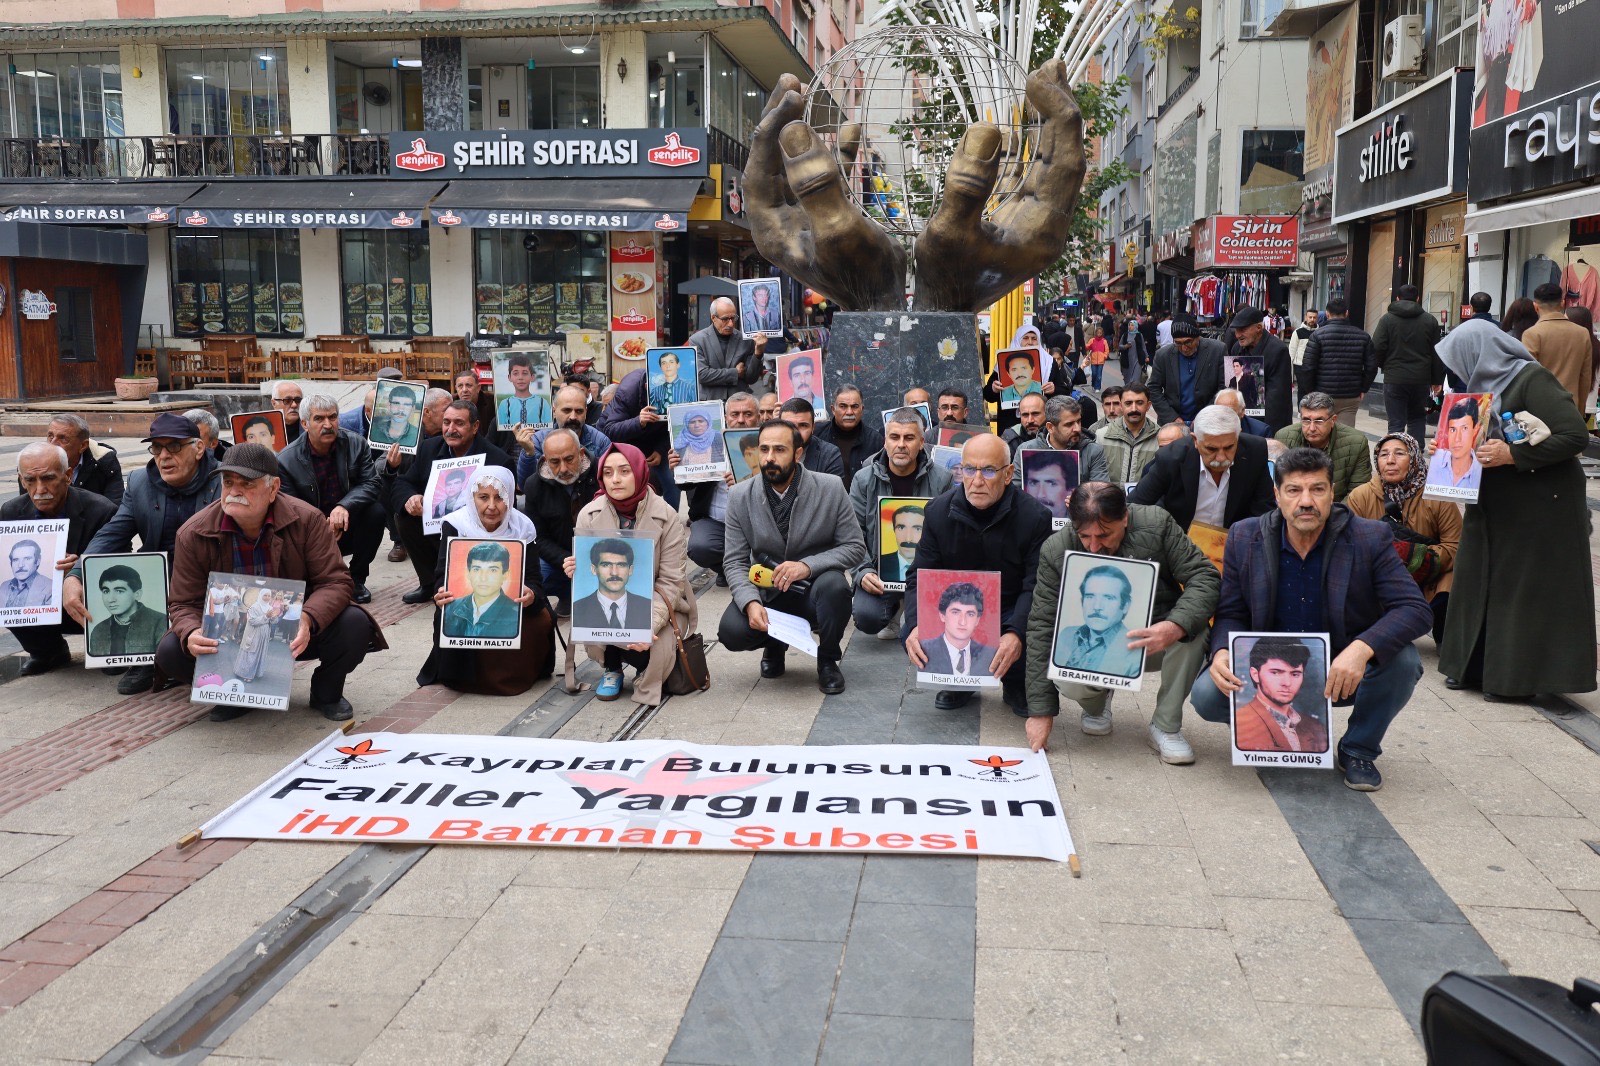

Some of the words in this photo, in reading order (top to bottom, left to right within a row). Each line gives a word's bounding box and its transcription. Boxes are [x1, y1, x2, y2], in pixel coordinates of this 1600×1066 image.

[453, 133, 525, 173] ŞEHİR
[533, 139, 638, 165] SOFRASI
[653, 149, 694, 163] şenpiliç
[1359, 115, 1411, 183] stilife
[401, 154, 439, 168] şenpiliç
[54, 208, 126, 220] SOFRASI
[233, 211, 286, 227] ŞEHİR
[291, 212, 366, 225] SOFRASI
[487, 211, 543, 227] ŞEHİR
[548, 213, 628, 227] SOFRASI
[1231, 219, 1282, 237] Şirin
[1428, 219, 1455, 245] stilife
[1220, 236, 1294, 247] Collection
[23, 302, 51, 313] BATMAN
[37, 523, 65, 533] ÇELİK
[4, 616, 38, 625] KAYBEDİLDİ
[105, 656, 133, 665] ÇETİN
[953, 676, 981, 685] KAVAK
[1058, 670, 1100, 682] İBRAHİM
[1102, 676, 1132, 688] ÇELİK
[199, 690, 246, 703] MERYEM
[247, 696, 283, 706] BULUT
[396, 752, 646, 774] Kayıplar
[662, 757, 952, 777] Bulunsun
[1243, 753, 1279, 763] Yılmaz
[1281, 753, 1322, 766] GÜMÜŞ
[269, 777, 543, 808] Failler
[570, 786, 1057, 819] Yargılansın
[277, 808, 410, 838] İHD
[428, 819, 702, 846] Batman
[730, 826, 979, 850] Şubesi
